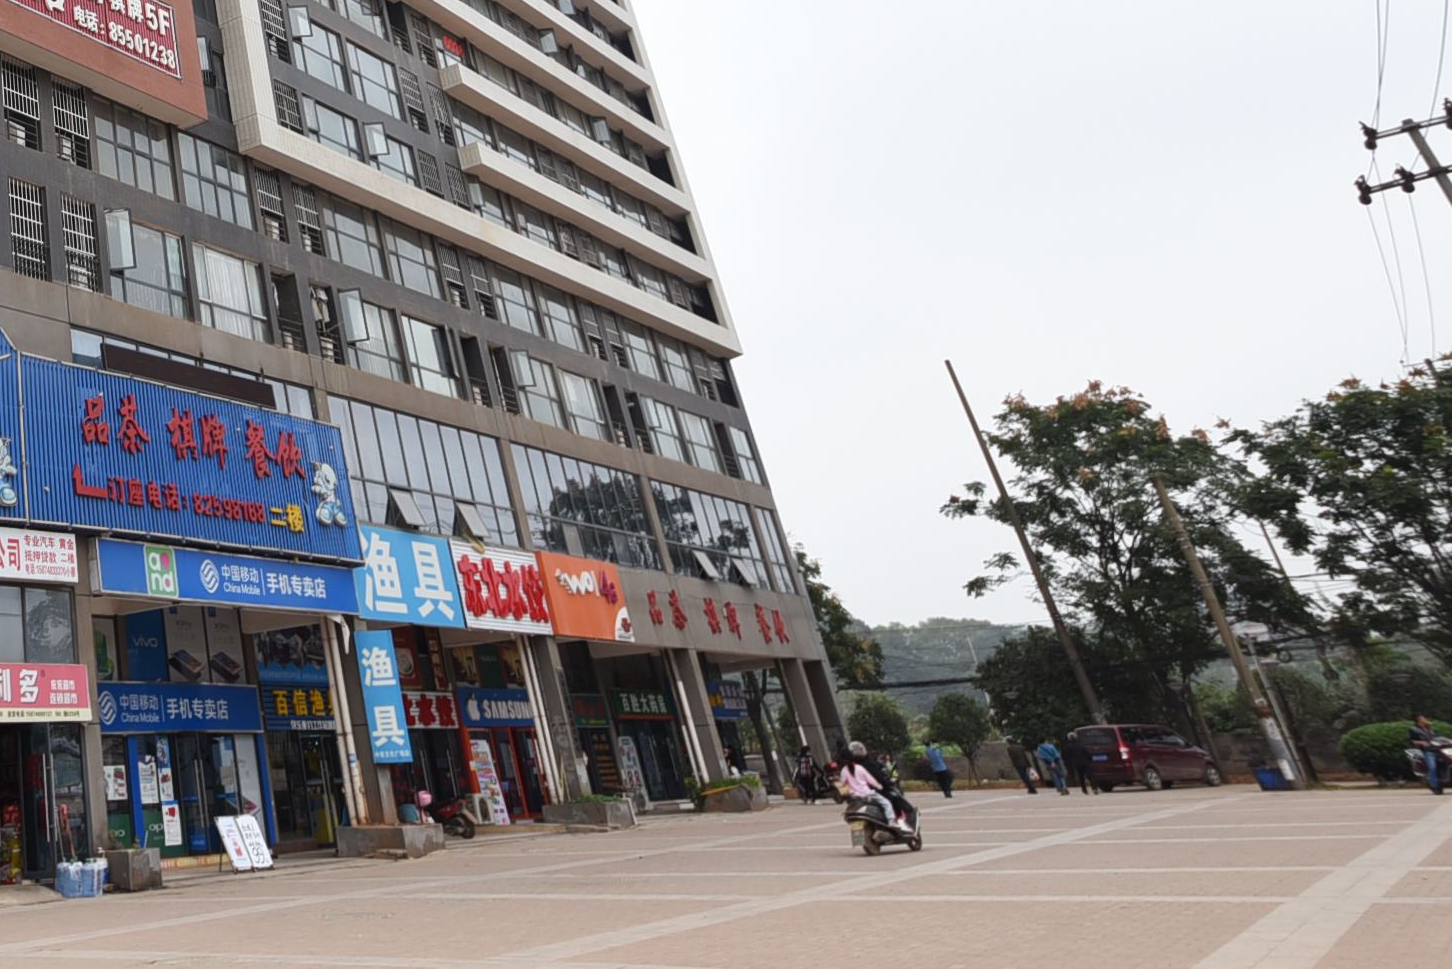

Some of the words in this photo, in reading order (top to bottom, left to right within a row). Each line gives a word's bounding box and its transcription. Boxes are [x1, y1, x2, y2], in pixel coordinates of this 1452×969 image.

[81, 394, 150, 455] 品茶
[166, 407, 230, 470] 棋牌
[245, 419, 307, 480] 餐饮
[269, 503, 305, 533] 二楼
[221, 564, 260, 584] 中国移动
[267, 572, 327, 599] 手机专卖店
[223, 582, 240, 595] China
[240, 584, 261, 596] Mobile
[360, 532, 455, 621] 渔具
[119, 694, 159, 711] 中国移动
[166, 698, 228, 720] 手机专卖店
[361, 646, 405, 748] 渔具
[121, 712, 138, 723] China
[140, 712, 160, 723] Mobile
